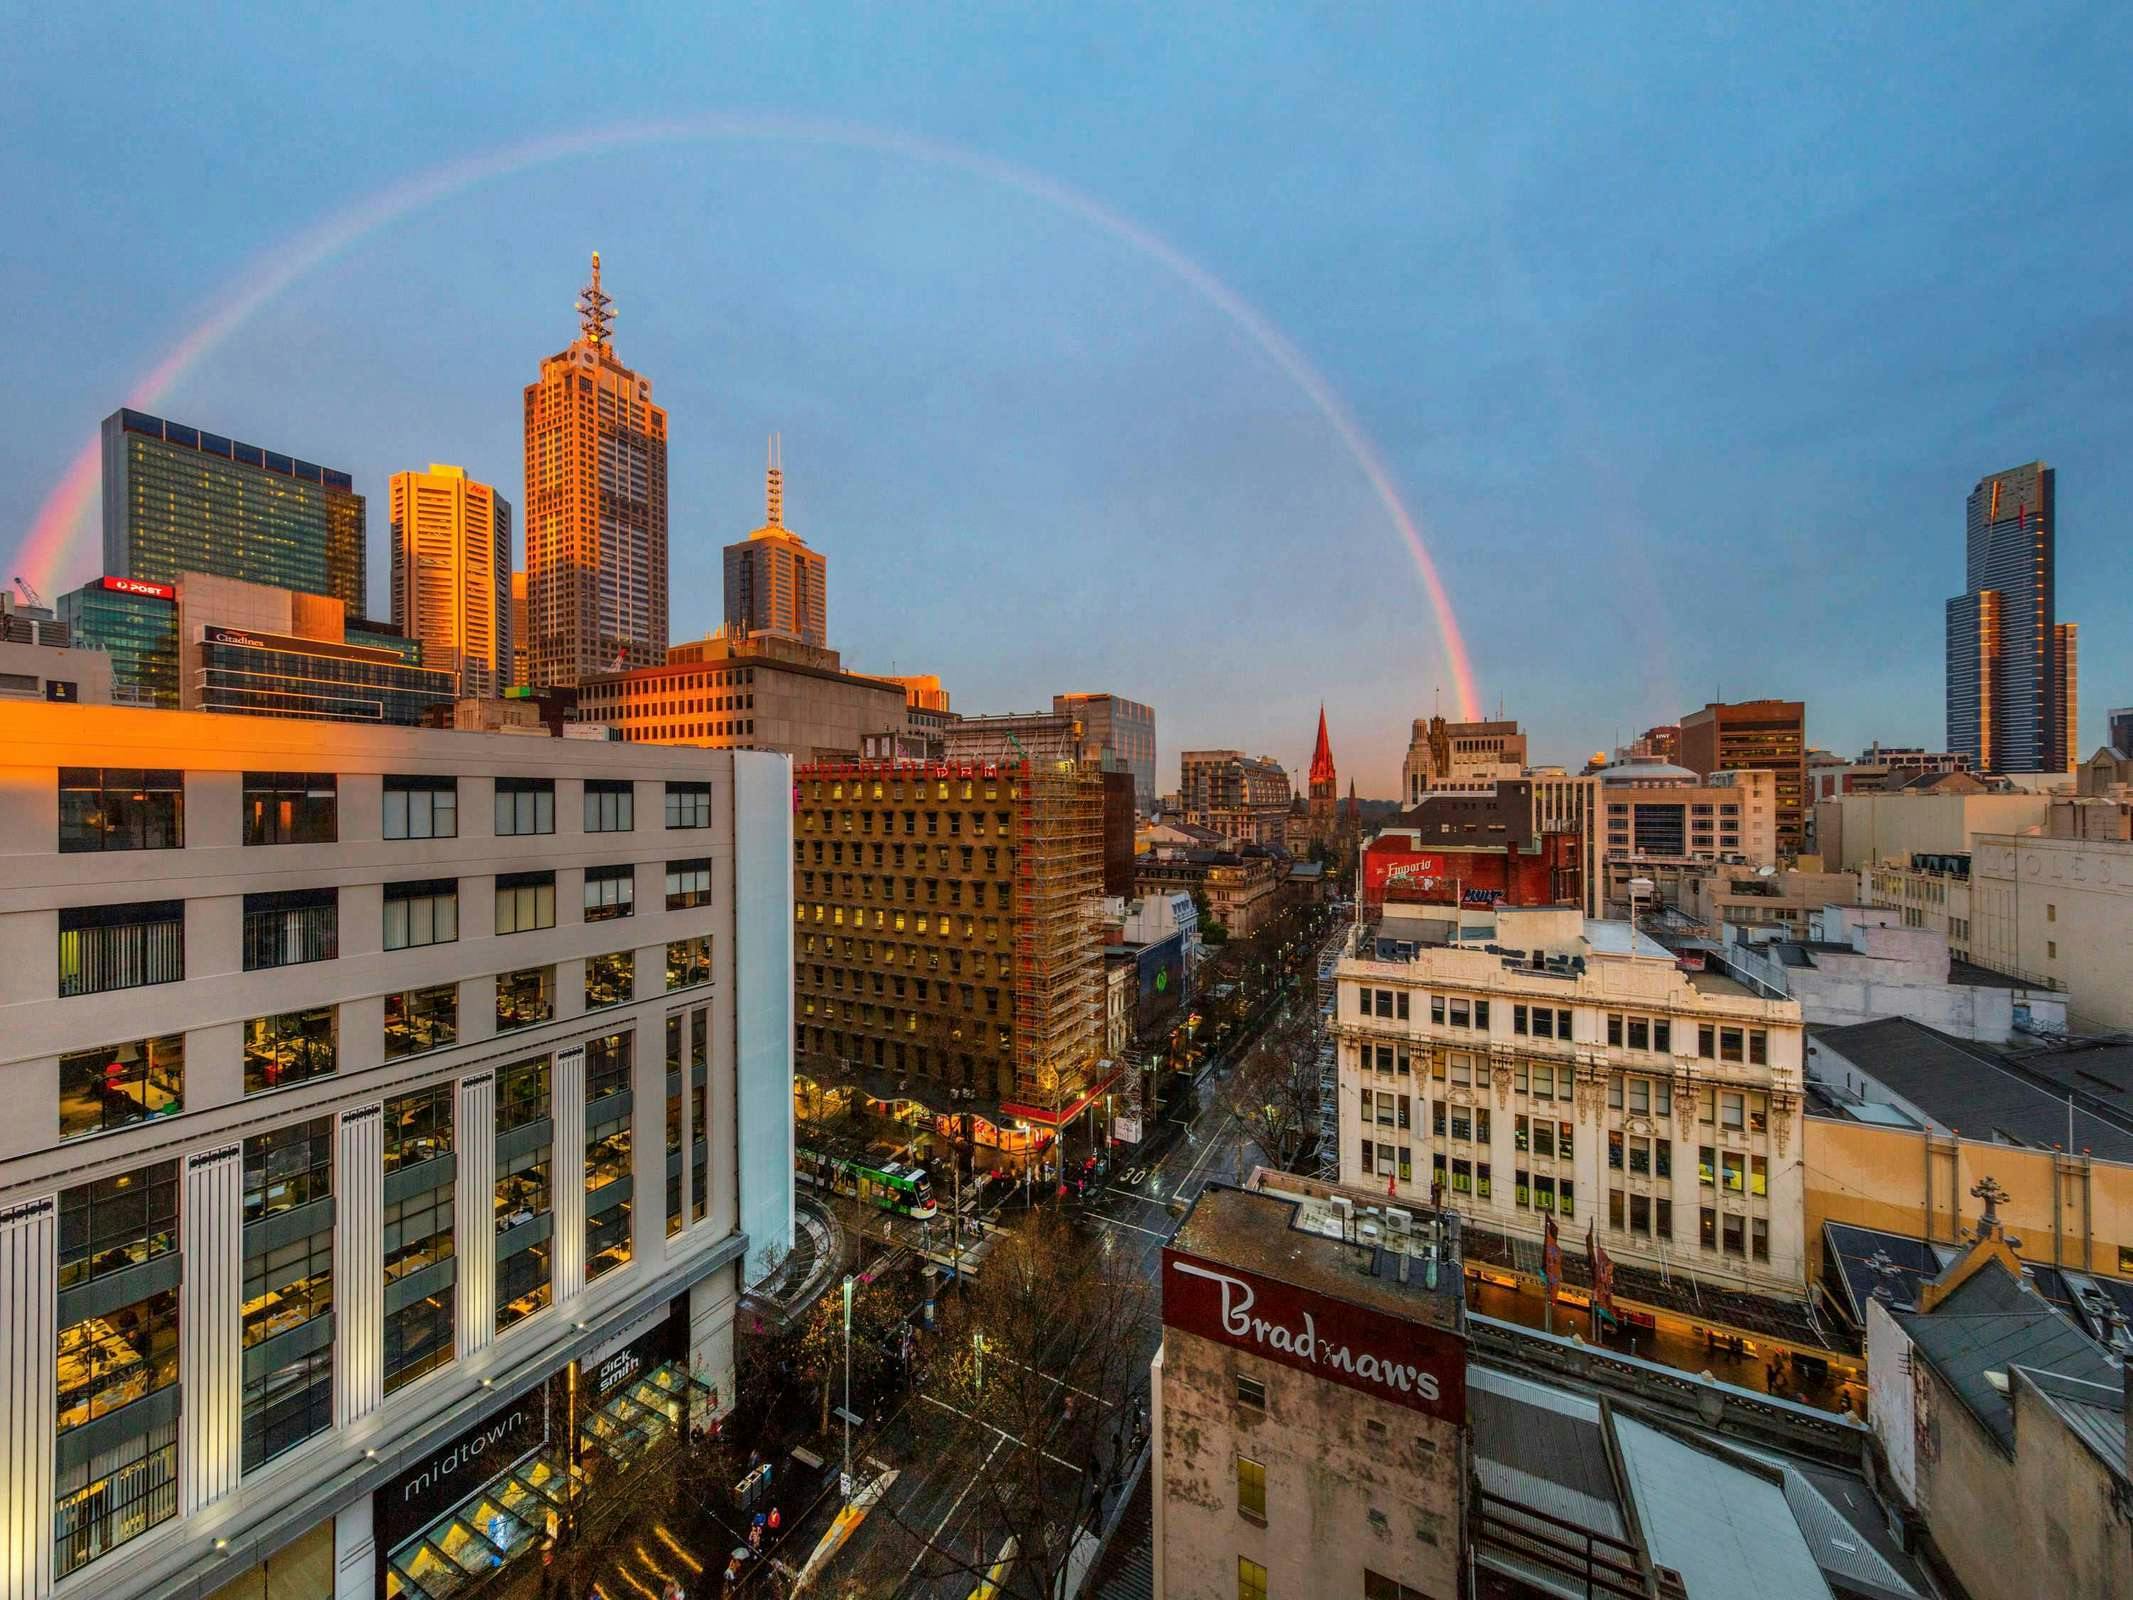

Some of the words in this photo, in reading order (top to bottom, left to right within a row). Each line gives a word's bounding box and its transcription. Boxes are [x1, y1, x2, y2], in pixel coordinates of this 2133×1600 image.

[130, 583, 162, 595] POST
[215, 632, 265, 648] Citadines
[1387, 859, 1432, 878] Emporio
[1120, 1167, 1147, 1185] 30
[600, 1350, 632, 1378] dick
[600, 1357, 640, 1392] smith
